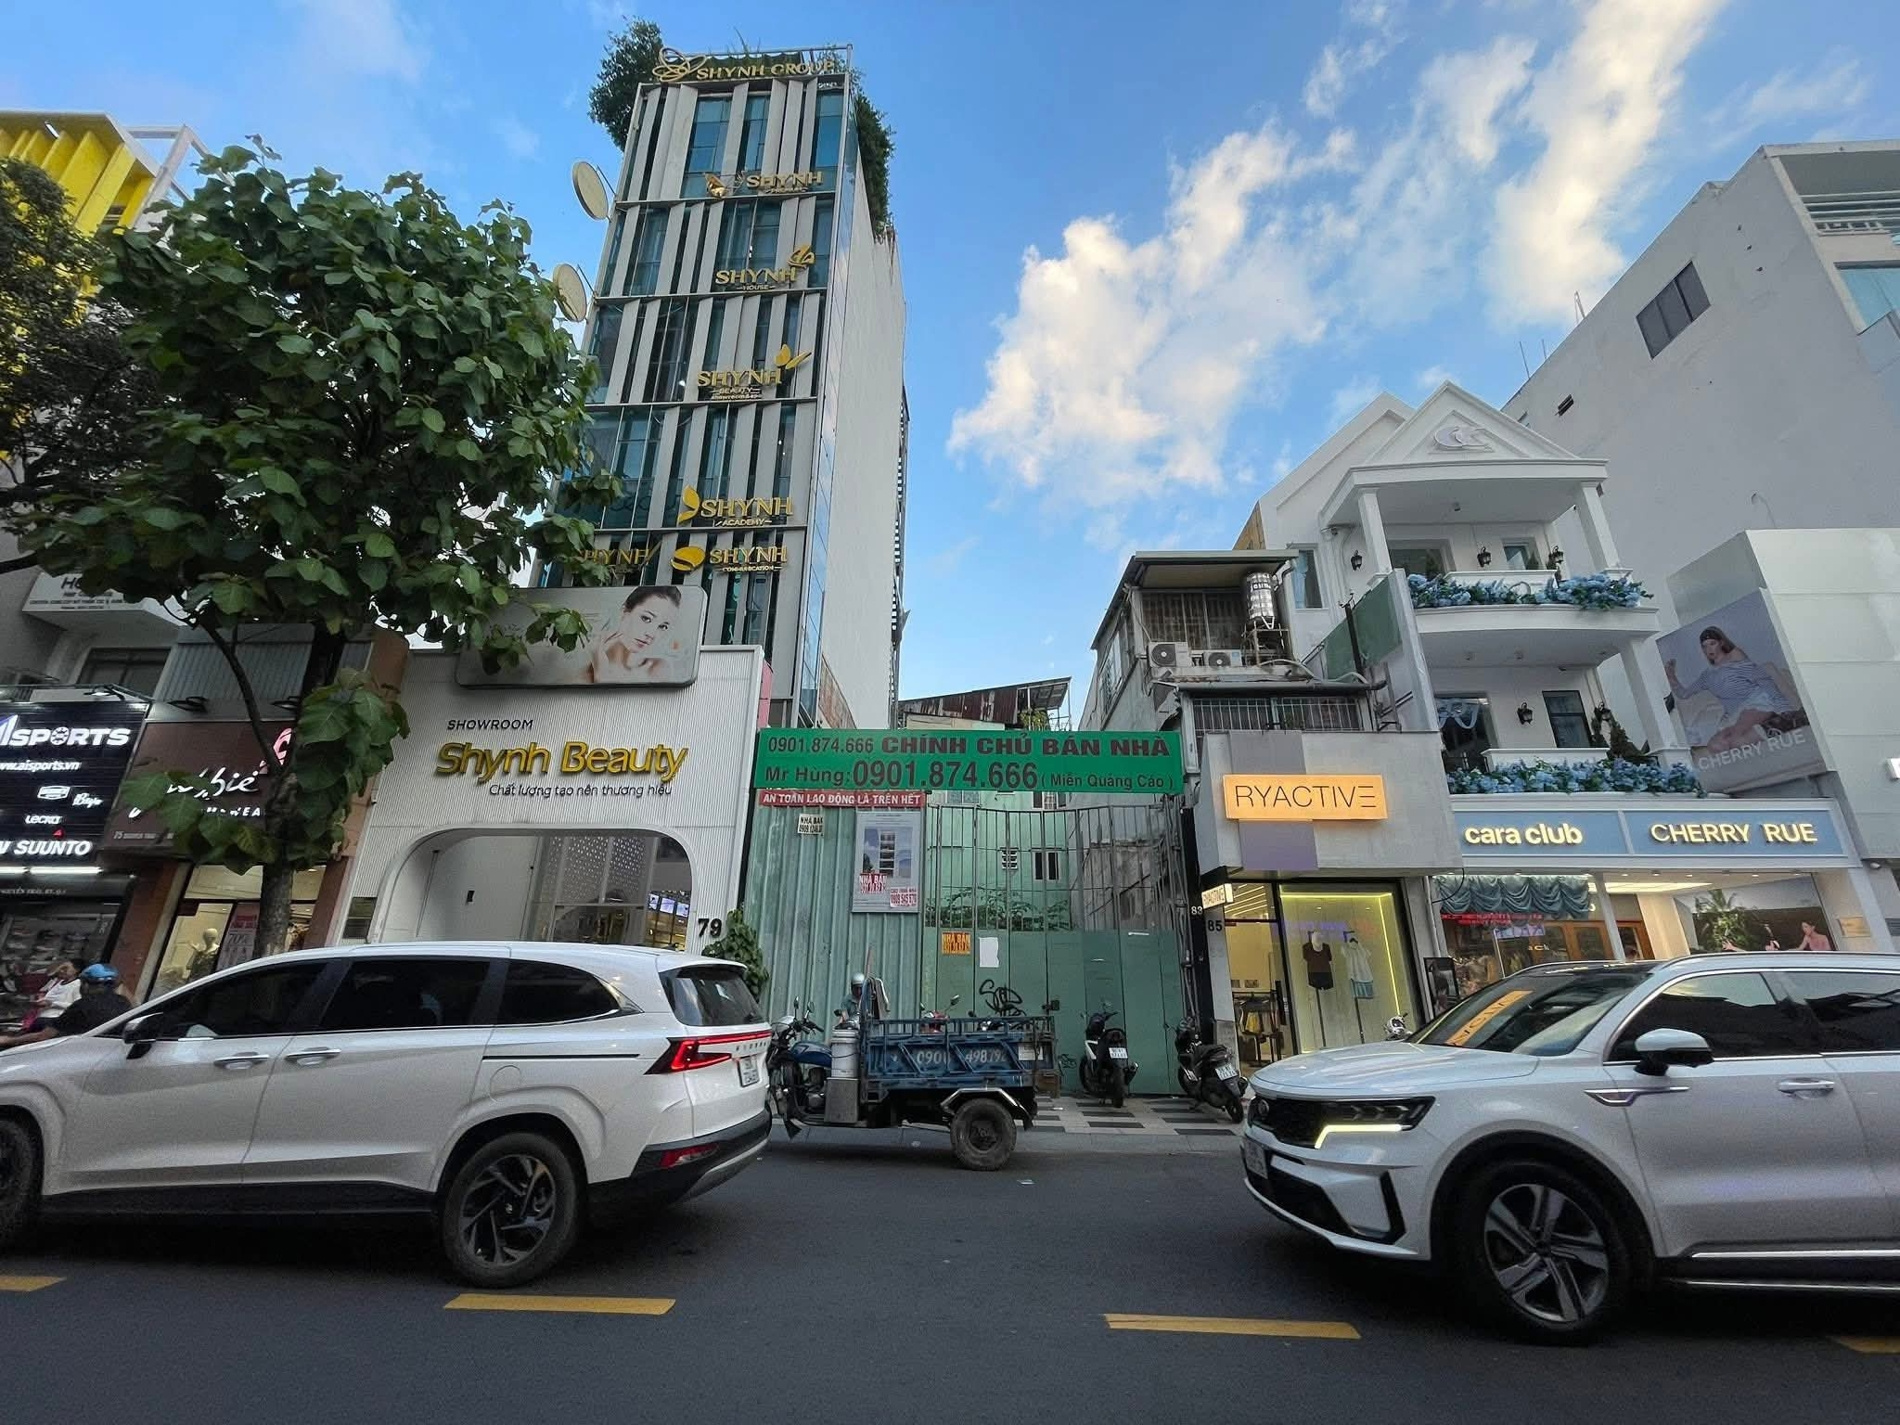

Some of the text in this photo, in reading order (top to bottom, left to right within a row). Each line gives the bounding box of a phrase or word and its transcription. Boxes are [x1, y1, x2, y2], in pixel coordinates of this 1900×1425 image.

[696, 60, 834, 80] SHYNH GROUP
[746, 171, 823, 189] SHYNH
[715, 267, 797, 285] SHYNH
[698, 368, 782, 387] SHYNH
[700, 496, 794, 518] SHYNH
[722, 518, 765, 527] ACADEMY
[709, 546, 788, 564] SHYNH
[447, 719, 534, 731] SHOWROOM
[768, 732, 1170, 756] 0901.874.666 CHÍNH CHỦ BÁN NHÀ
[1698, 729, 1806, 772] CHERRY RUE
[436, 741, 689, 785] Shynh Beauty
[765, 766, 788, 782] Mr
[852, 760, 1038, 789] 0901.874.666
[518, 783, 552, 798] lượng
[555, 786, 574, 797] tạo
[576, 783, 599, 796] nên
[602, 784, 644, 799] thương
[763, 791, 921, 806] AN TOÀN LAO ĐỘNG LÀ TRÊN HẾT
[1235, 785, 1377, 808] RYACTIVE
[1463, 823, 1584, 845] cara club
[1650, 823, 1818, 843] CHERRY RUE
[14, 839, 92, 856] SUUNTO
[698, 918, 723, 938] 79
[1208, 920, 1223, 932] 85
